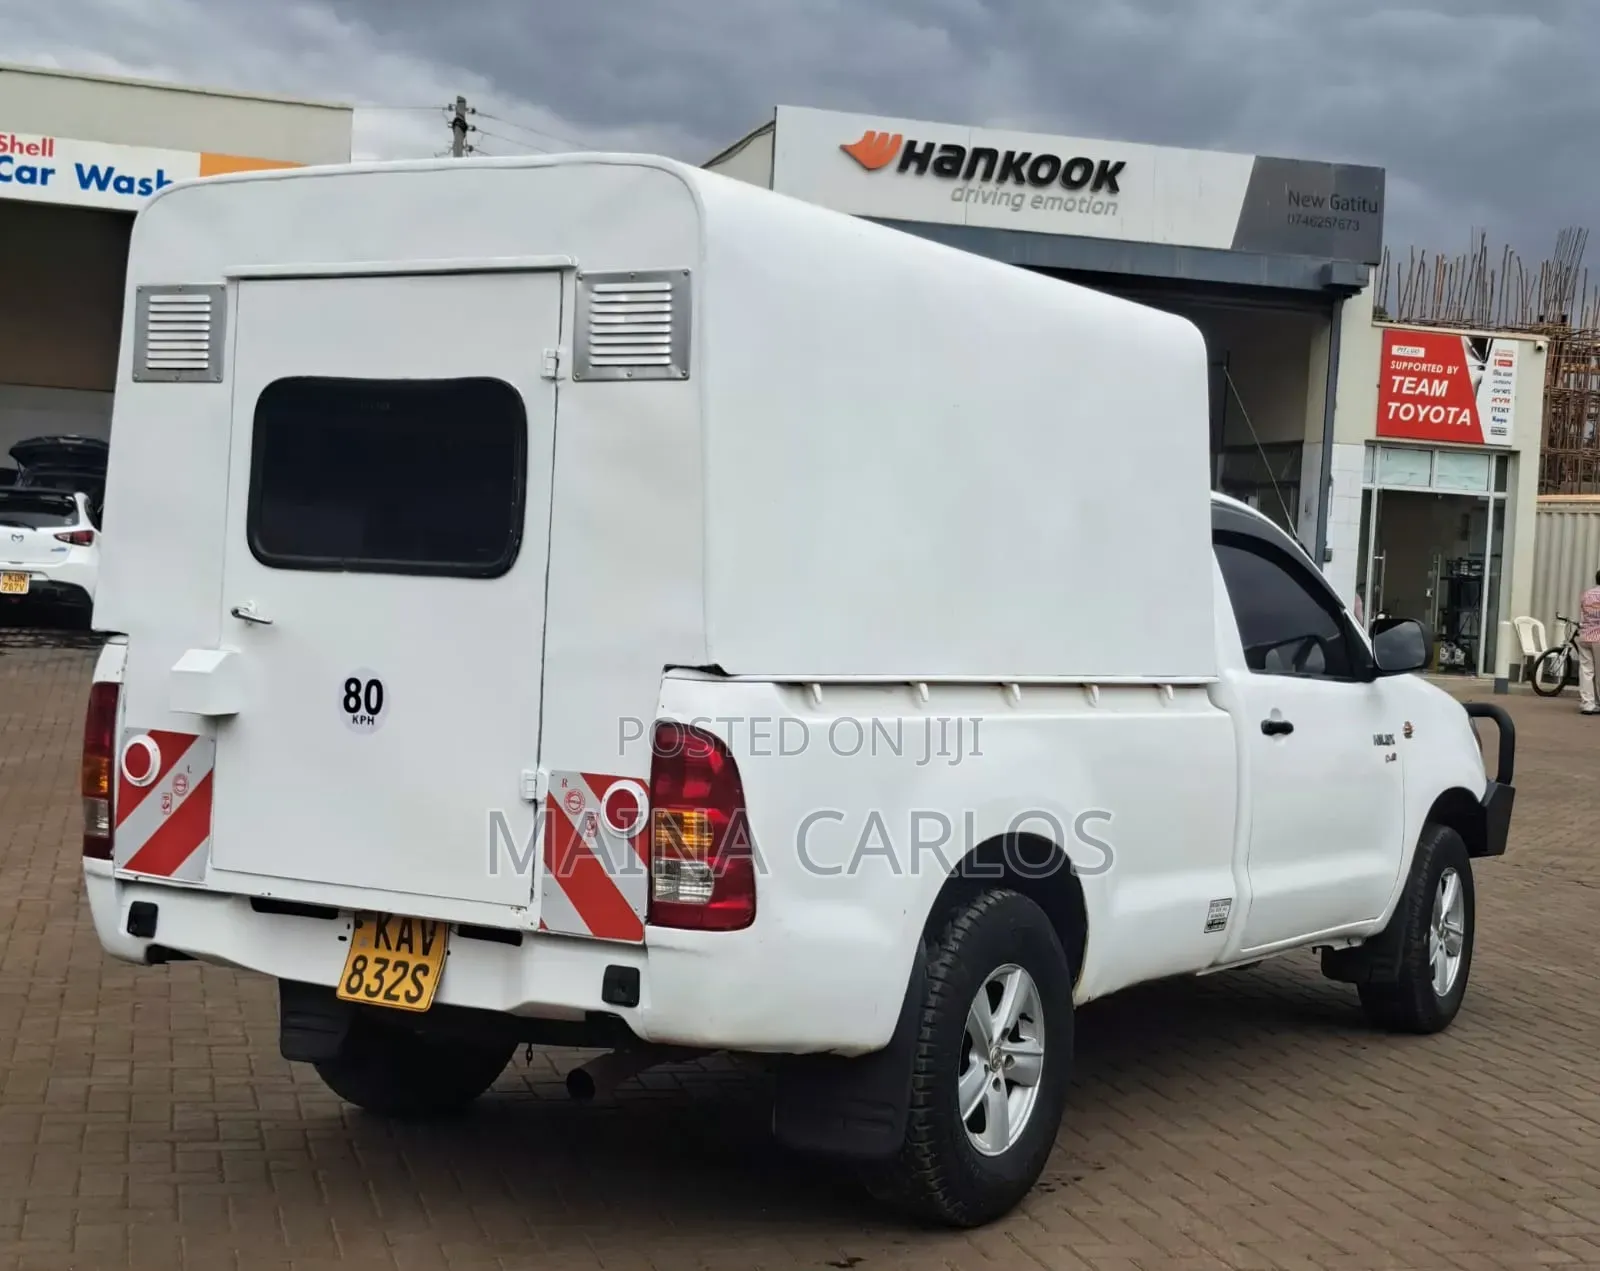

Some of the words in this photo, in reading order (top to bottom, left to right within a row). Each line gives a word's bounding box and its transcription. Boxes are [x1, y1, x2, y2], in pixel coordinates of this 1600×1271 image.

[0, 134, 54, 157] Shell
[0, 155, 55, 186] Car
[951, 186, 1025, 212] driving
[1030, 194, 1118, 216] emotion
[1288, 190, 1326, 208] New
[1329, 194, 1378, 213] Gatitu
[1390, 360, 1443, 373] SUPPORTED
[1446, 365, 1460, 375] BY
[1391, 376, 1449, 397] TEAM
[1387, 402, 1472, 426] TOYOTA
[343, 677, 384, 715] 80
[352, 715, 375, 726] KPH
[374, 911, 438, 956] KAV
[345, 954, 430, 1004] 832S
